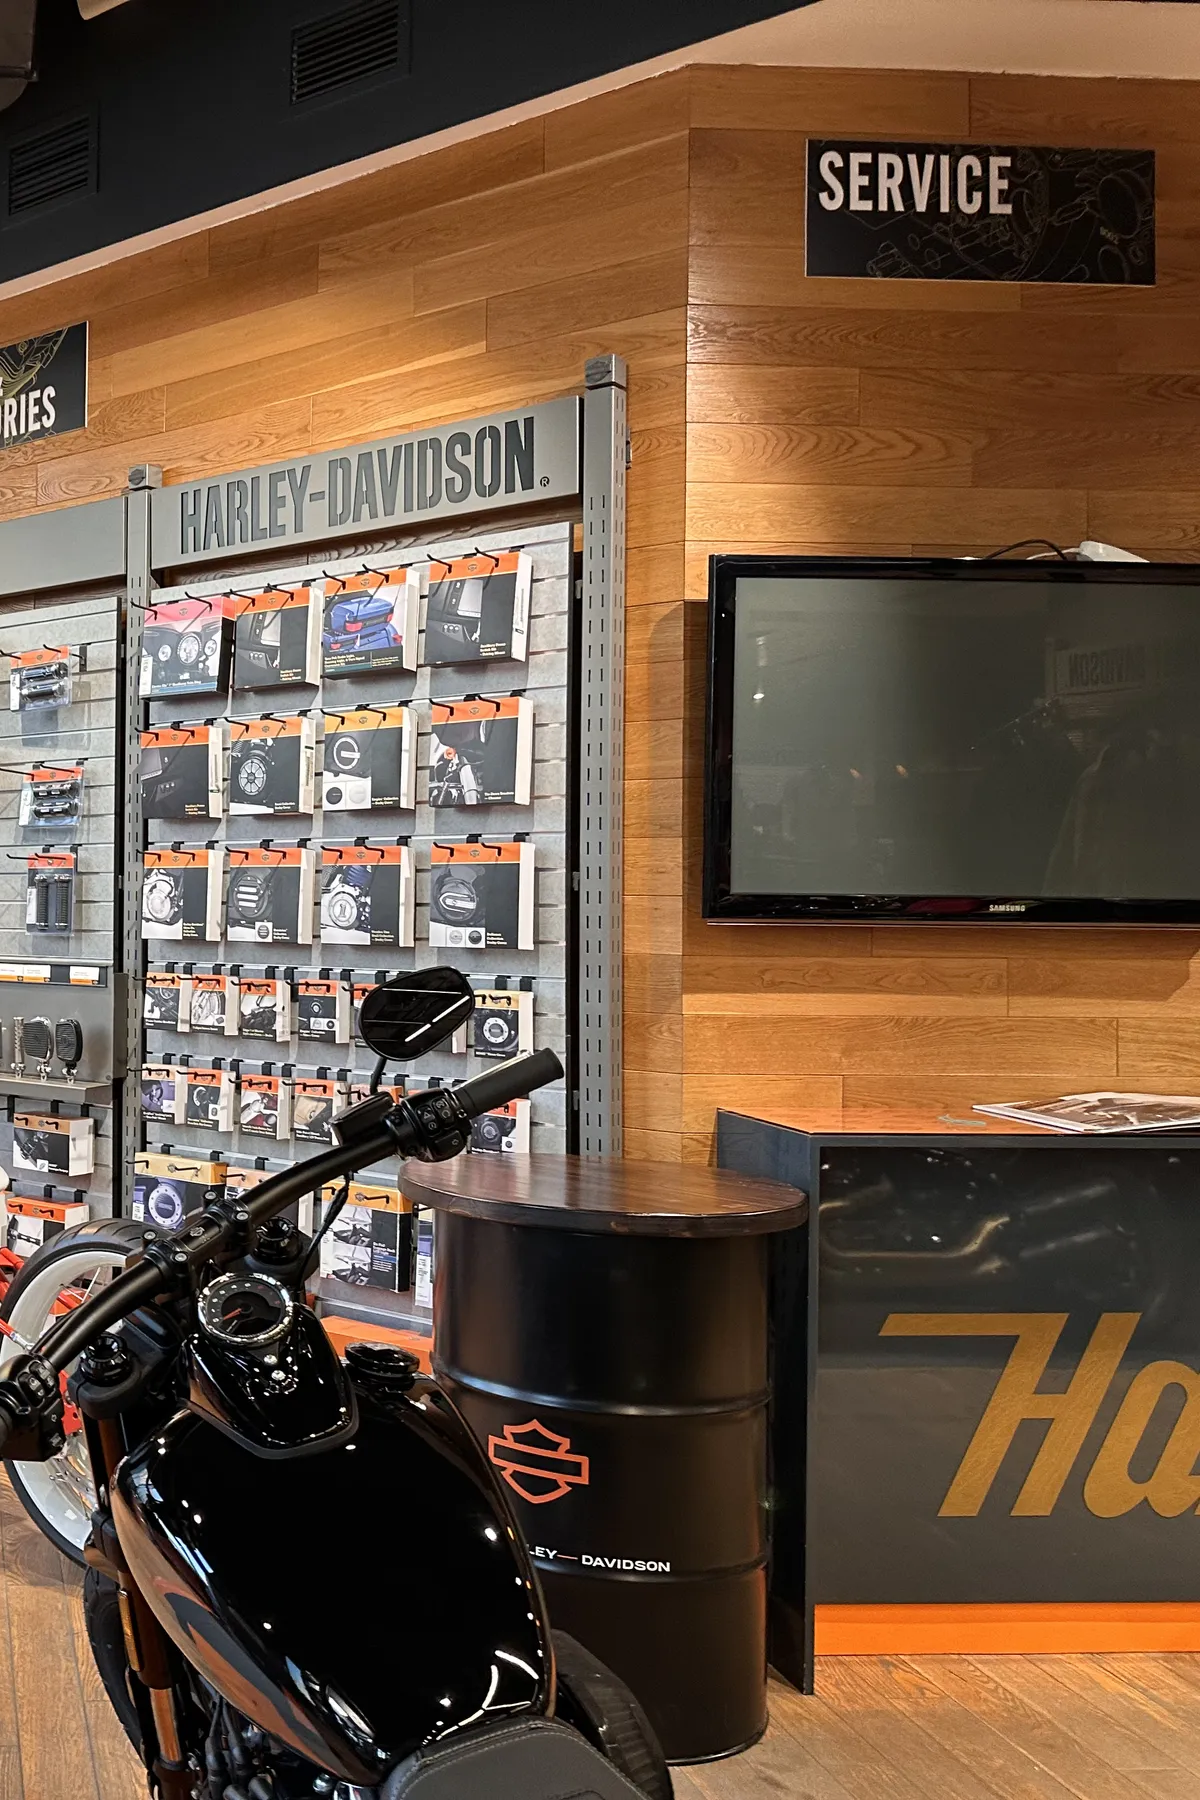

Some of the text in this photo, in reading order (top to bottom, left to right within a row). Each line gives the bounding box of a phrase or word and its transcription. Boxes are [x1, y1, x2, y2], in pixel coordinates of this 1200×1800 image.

[818, 150, 1013, 215] SERVICE
[989, 904, 1026, 912] SAMSUNG
[878, 1312, 1200, 1519] Ha
